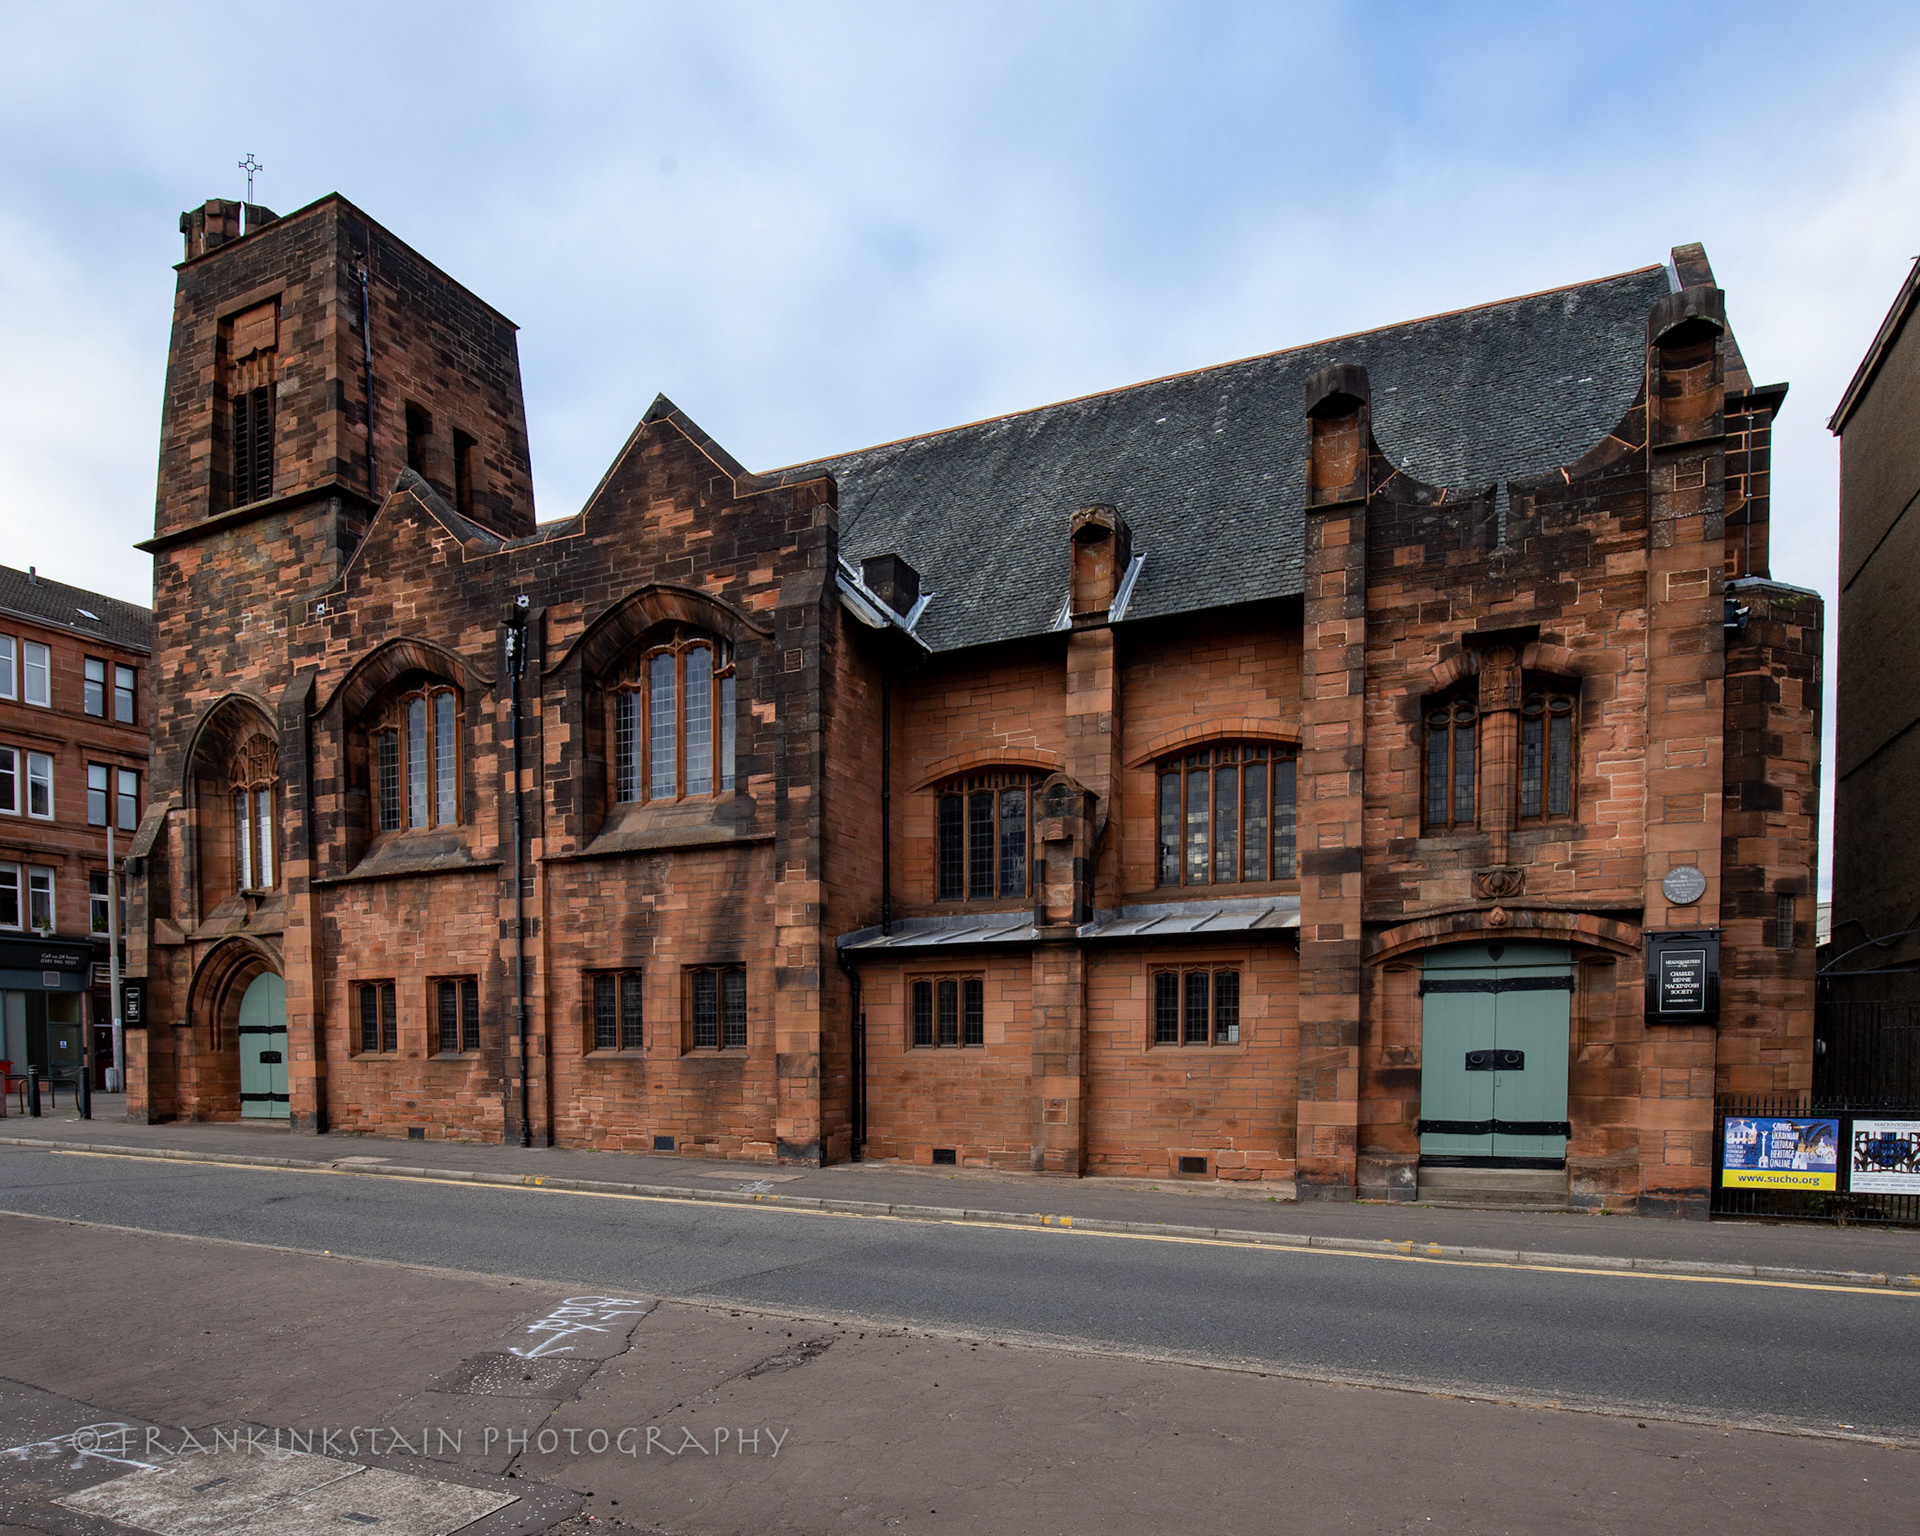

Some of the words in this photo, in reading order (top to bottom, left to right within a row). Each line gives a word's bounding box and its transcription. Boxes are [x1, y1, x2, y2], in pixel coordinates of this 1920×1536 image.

[1772, 1122, 1792, 1132] SAVING
[1771, 1131, 1800, 1140] UKRAINIAN
[1771, 1140, 1795, 1150] CULTURAL
[1770, 1149, 1795, 1159] HERITAGE
[1769, 1159, 1792, 1168] ONLINE
[1738, 1174, 1820, 1186] www.sucho.org
